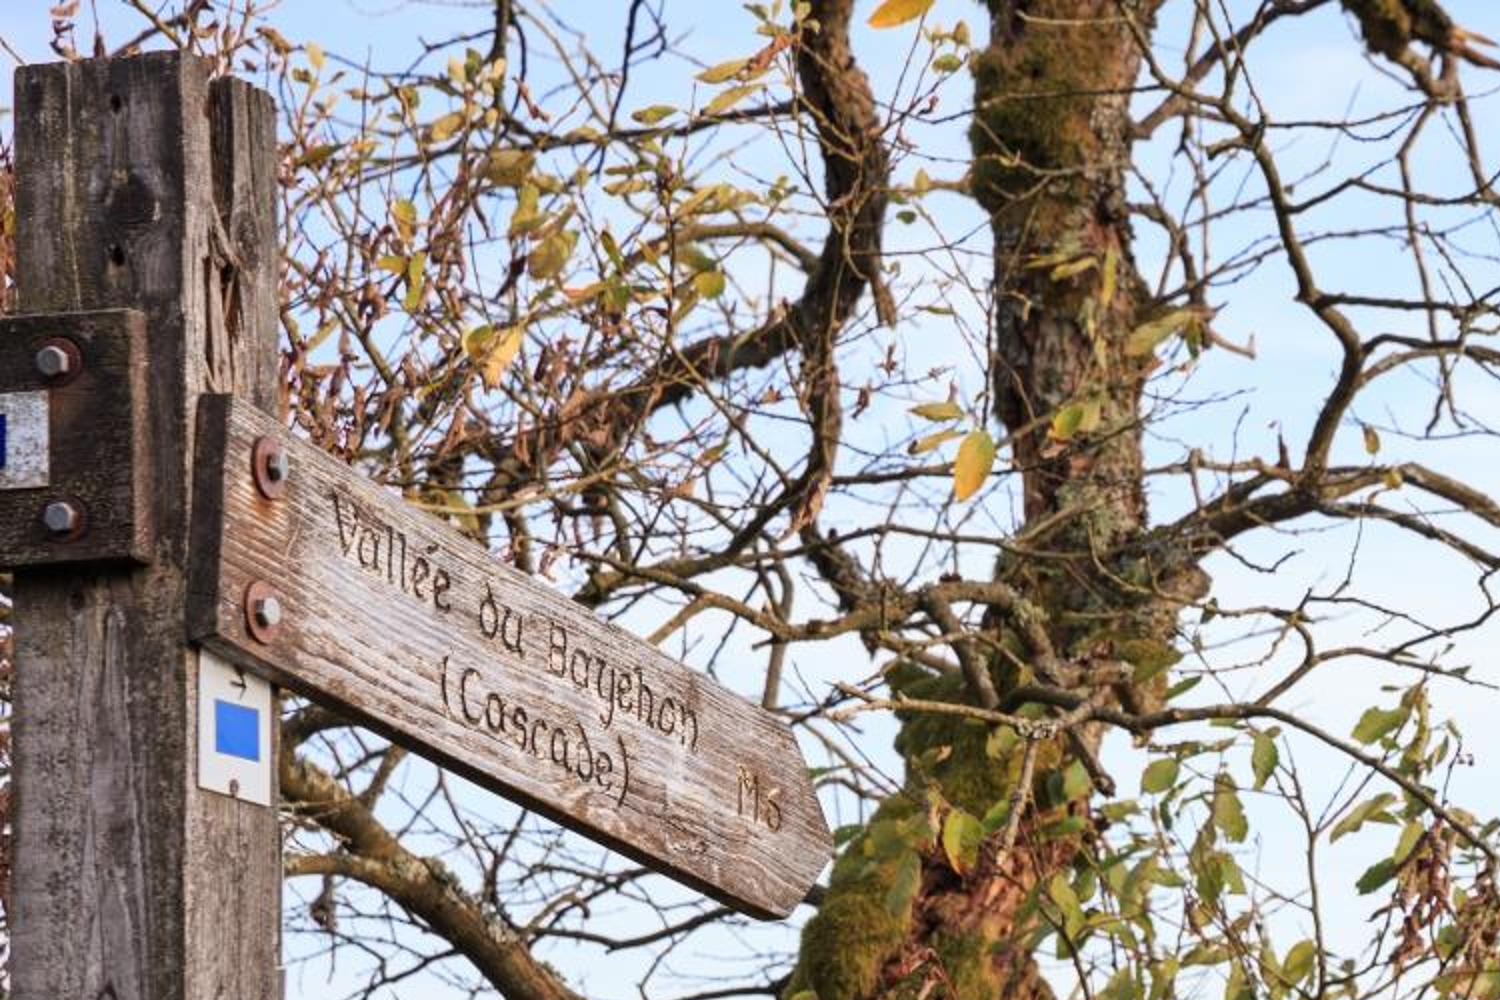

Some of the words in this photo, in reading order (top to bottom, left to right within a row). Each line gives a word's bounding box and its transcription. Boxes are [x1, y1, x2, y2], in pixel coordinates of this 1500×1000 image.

[331, 487, 451, 613] Vallée
[480, 581, 523, 657] du
[549, 621, 699, 753] Bayehon
[441, 656, 629, 807] (Cascade)
